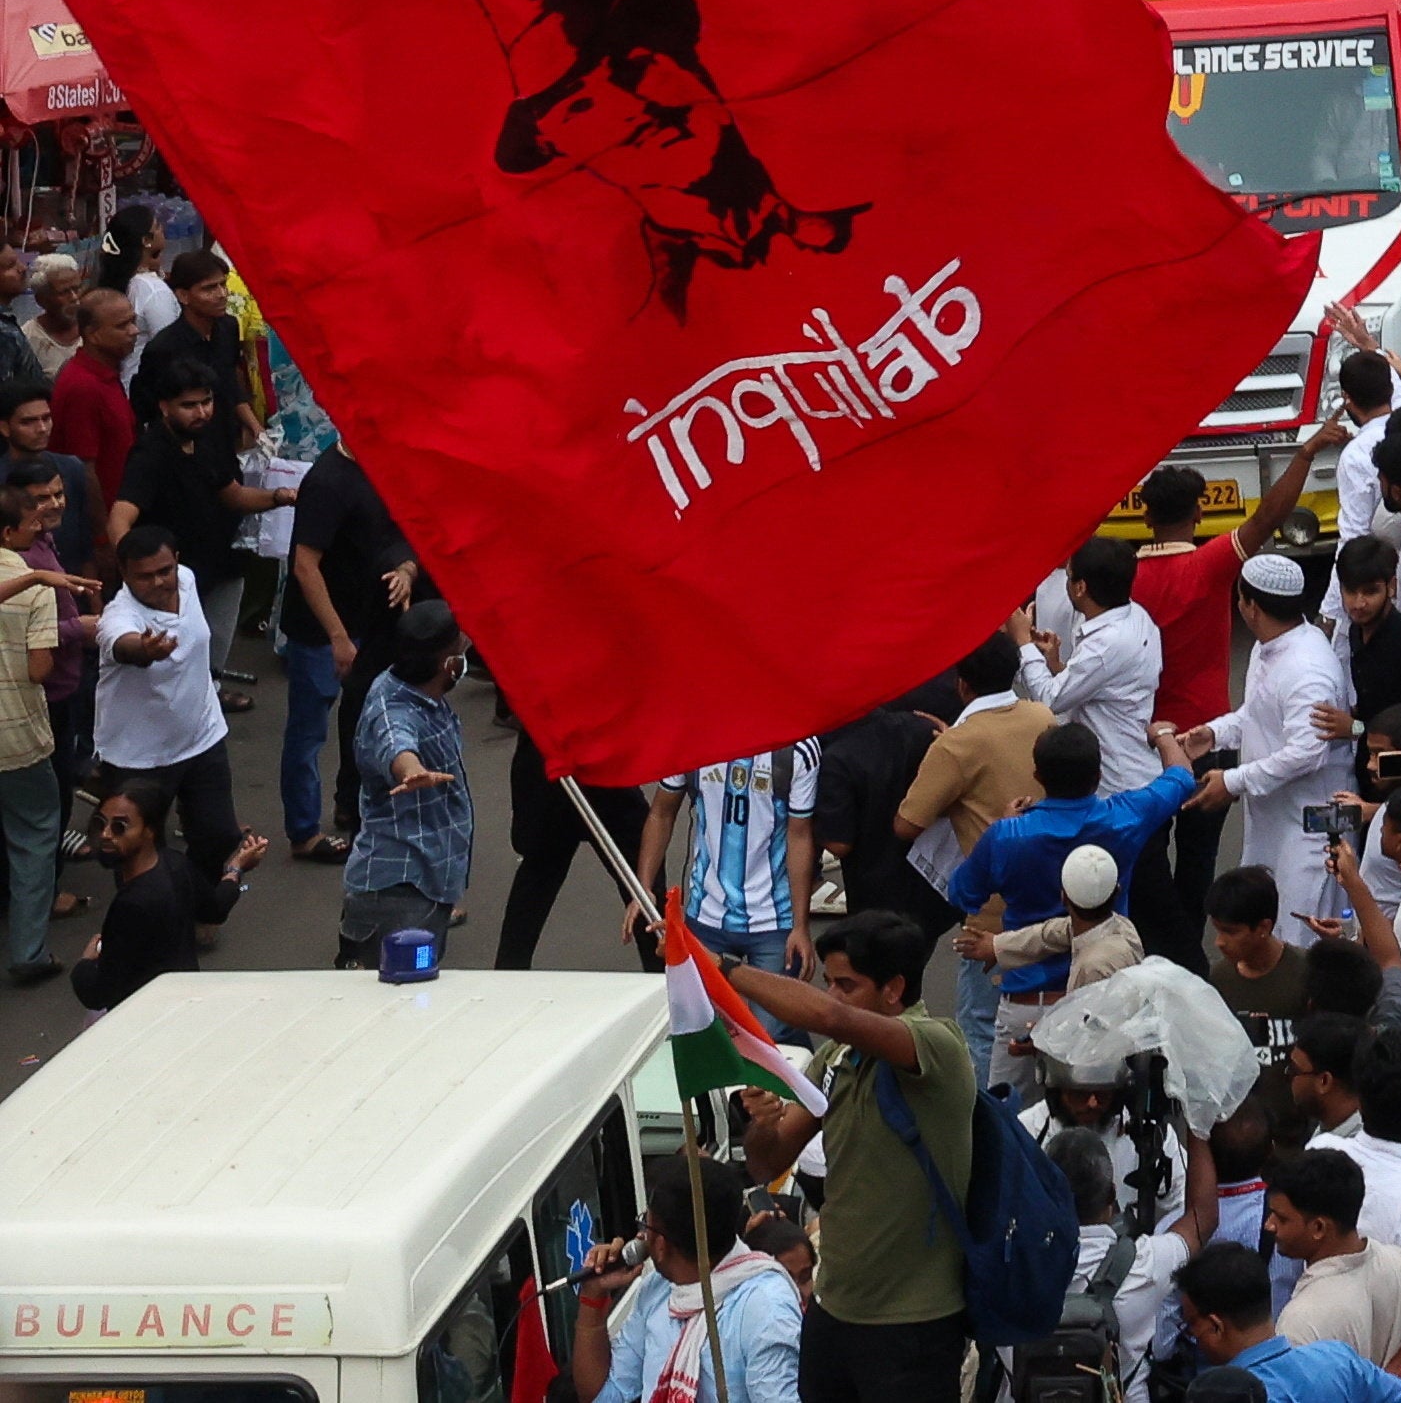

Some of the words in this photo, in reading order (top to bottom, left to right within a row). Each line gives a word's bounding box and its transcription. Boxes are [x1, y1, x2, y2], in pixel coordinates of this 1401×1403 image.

[1263, 37, 1375, 70] SERVICE
[626, 256, 983, 521] inquilab
[725, 793, 750, 826] 10
